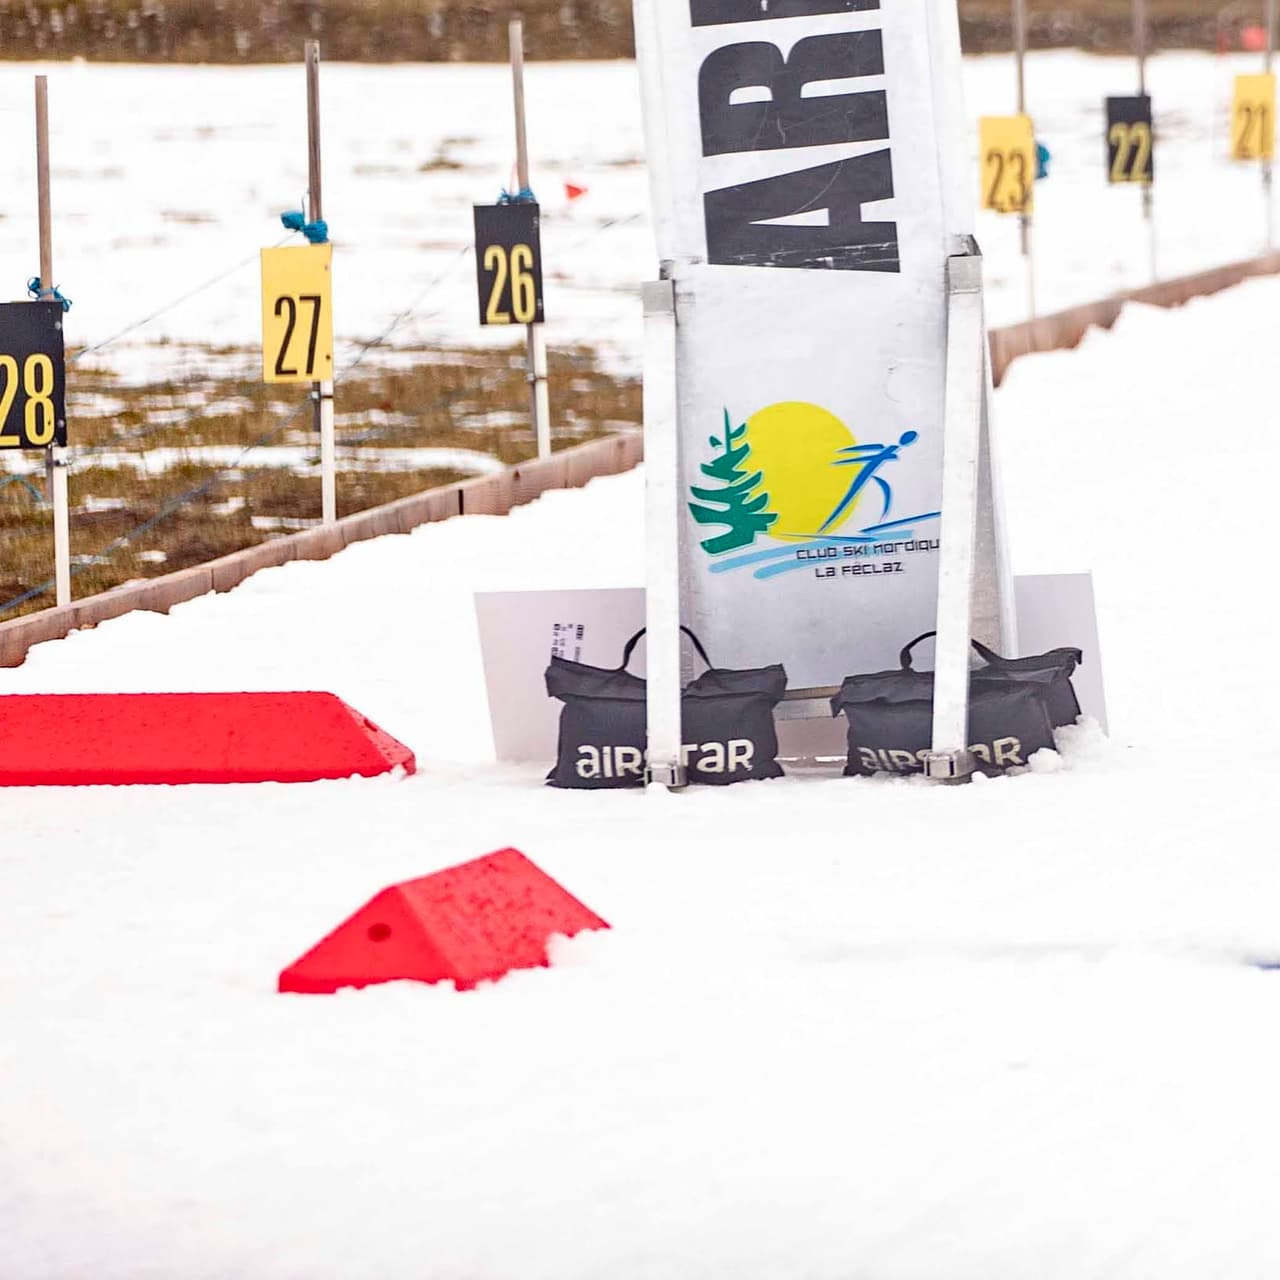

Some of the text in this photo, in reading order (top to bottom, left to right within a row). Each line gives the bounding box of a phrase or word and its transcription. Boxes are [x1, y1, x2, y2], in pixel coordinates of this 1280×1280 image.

[1109, 121, 1152, 183] 22
[1236, 102, 1266, 158] 21
[986, 150, 1026, 212] 23
[483, 243, 536, 325] 26
[274, 295, 321, 375] 27
[0, 353, 55, 446] 28
[873, 538, 940, 551] nordiqu
